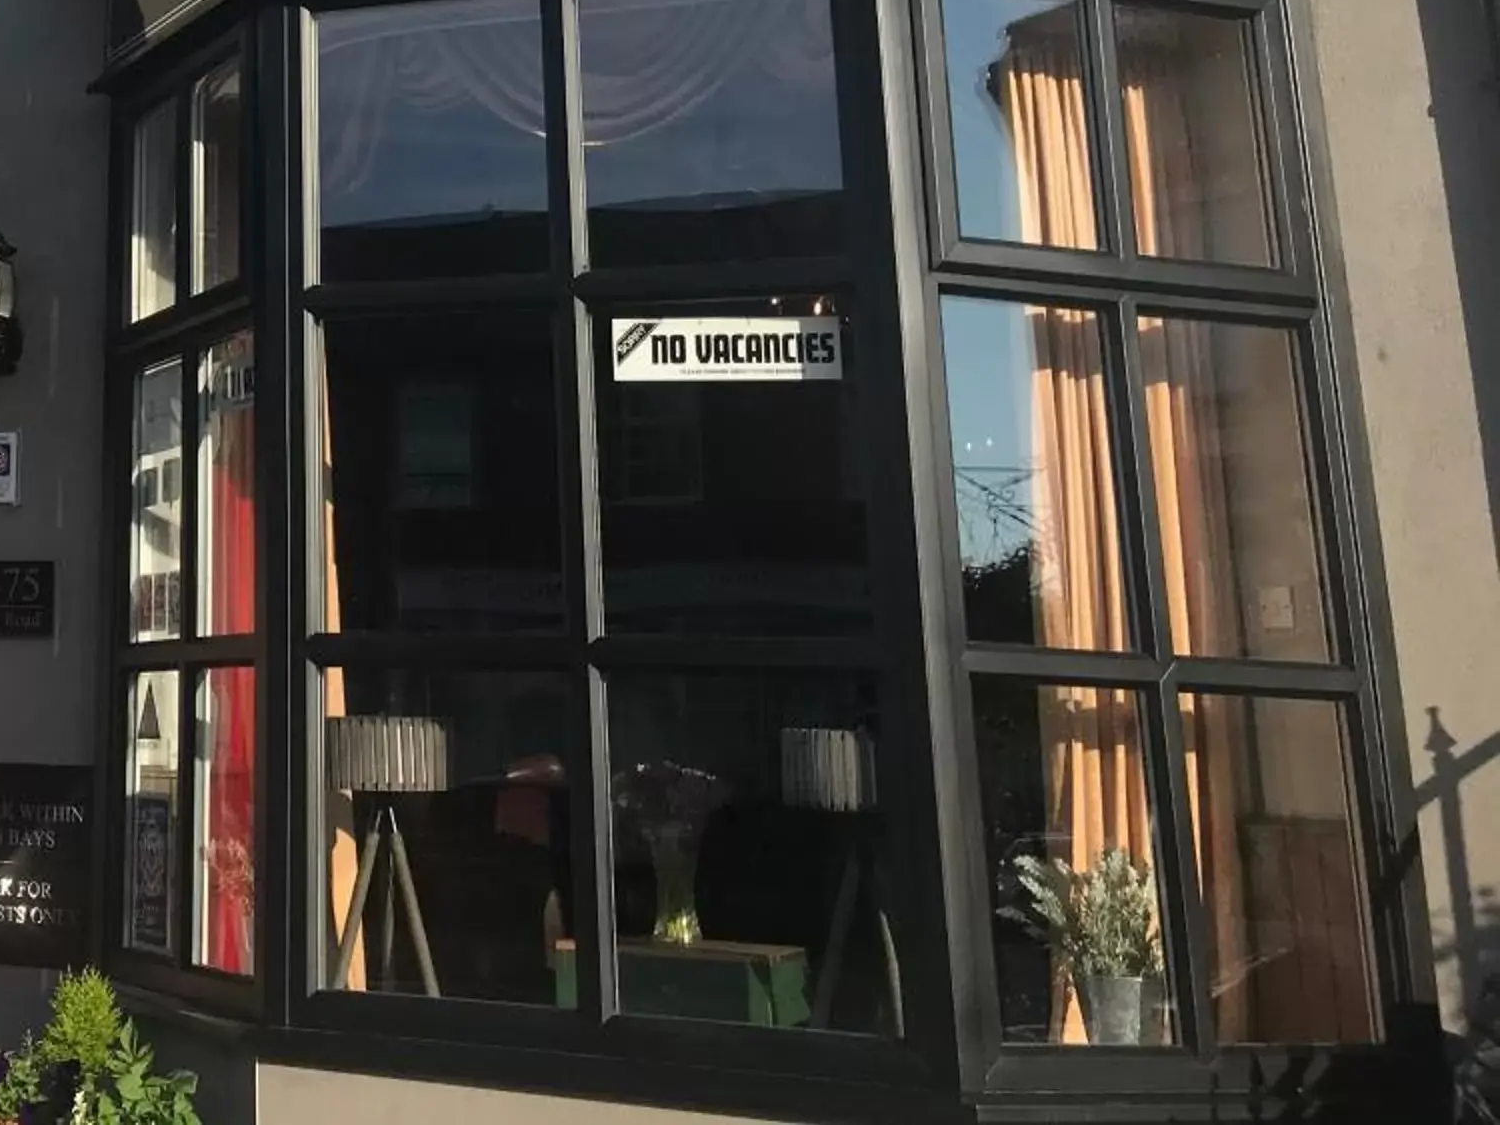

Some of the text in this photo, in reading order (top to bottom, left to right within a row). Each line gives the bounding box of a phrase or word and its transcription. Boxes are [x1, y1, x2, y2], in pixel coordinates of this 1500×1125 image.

[651, 332, 835, 365] NO VACANCIES
[19, 803, 85, 823] WITHIN
[8, 829, 56, 850] BAYS
[16, 880, 53, 899] FOR
